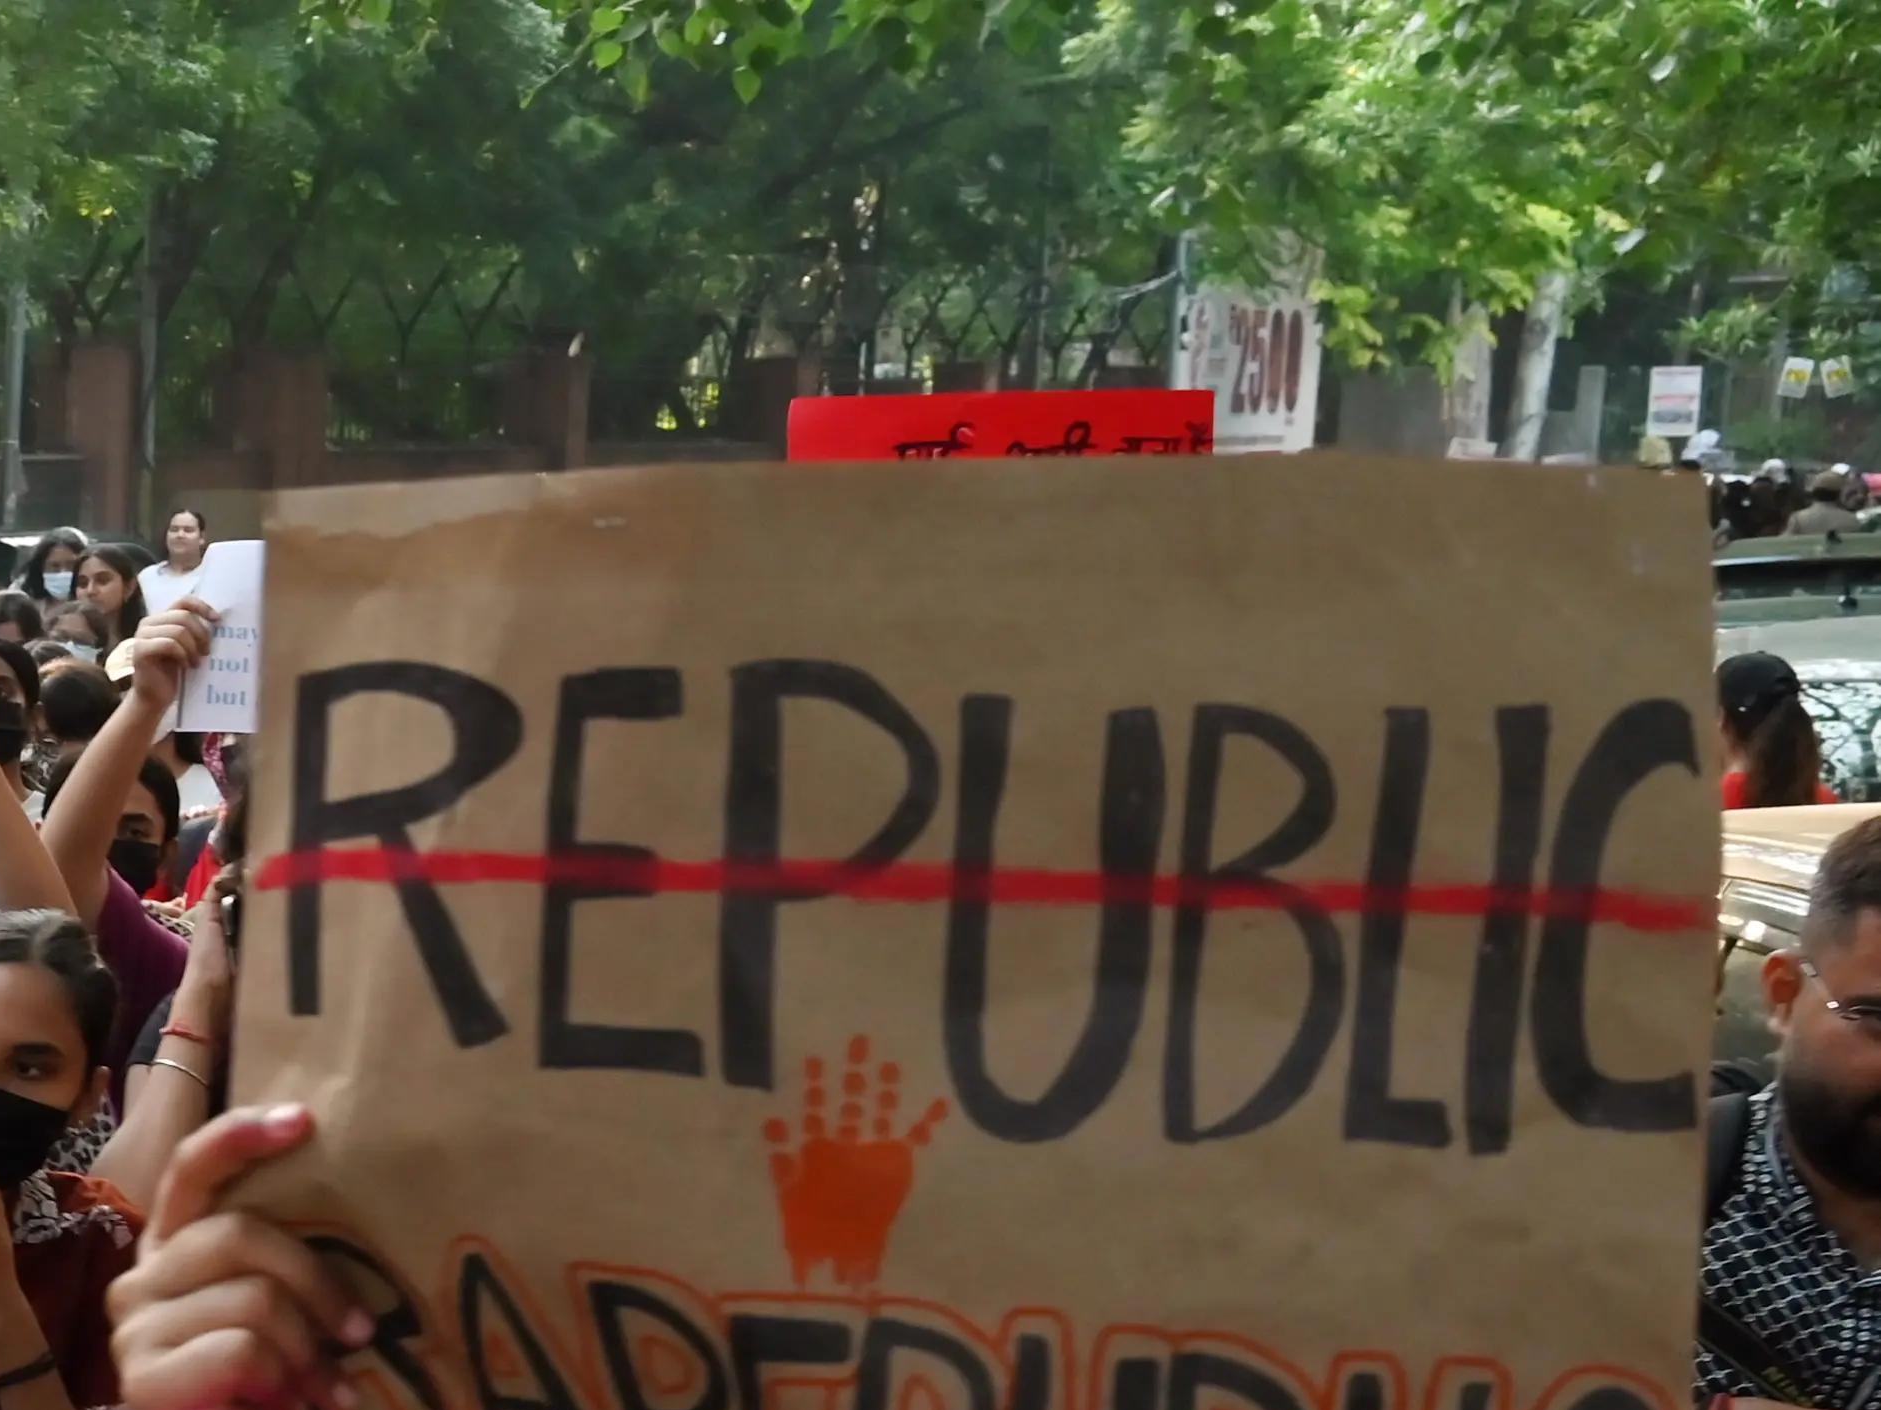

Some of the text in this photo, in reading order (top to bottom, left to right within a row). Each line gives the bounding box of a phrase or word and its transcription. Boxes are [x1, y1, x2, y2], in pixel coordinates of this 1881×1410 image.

[208, 655, 250, 674] not
[205, 683, 247, 706] but
[287, 657, 1703, 1155] REPUBLIC
